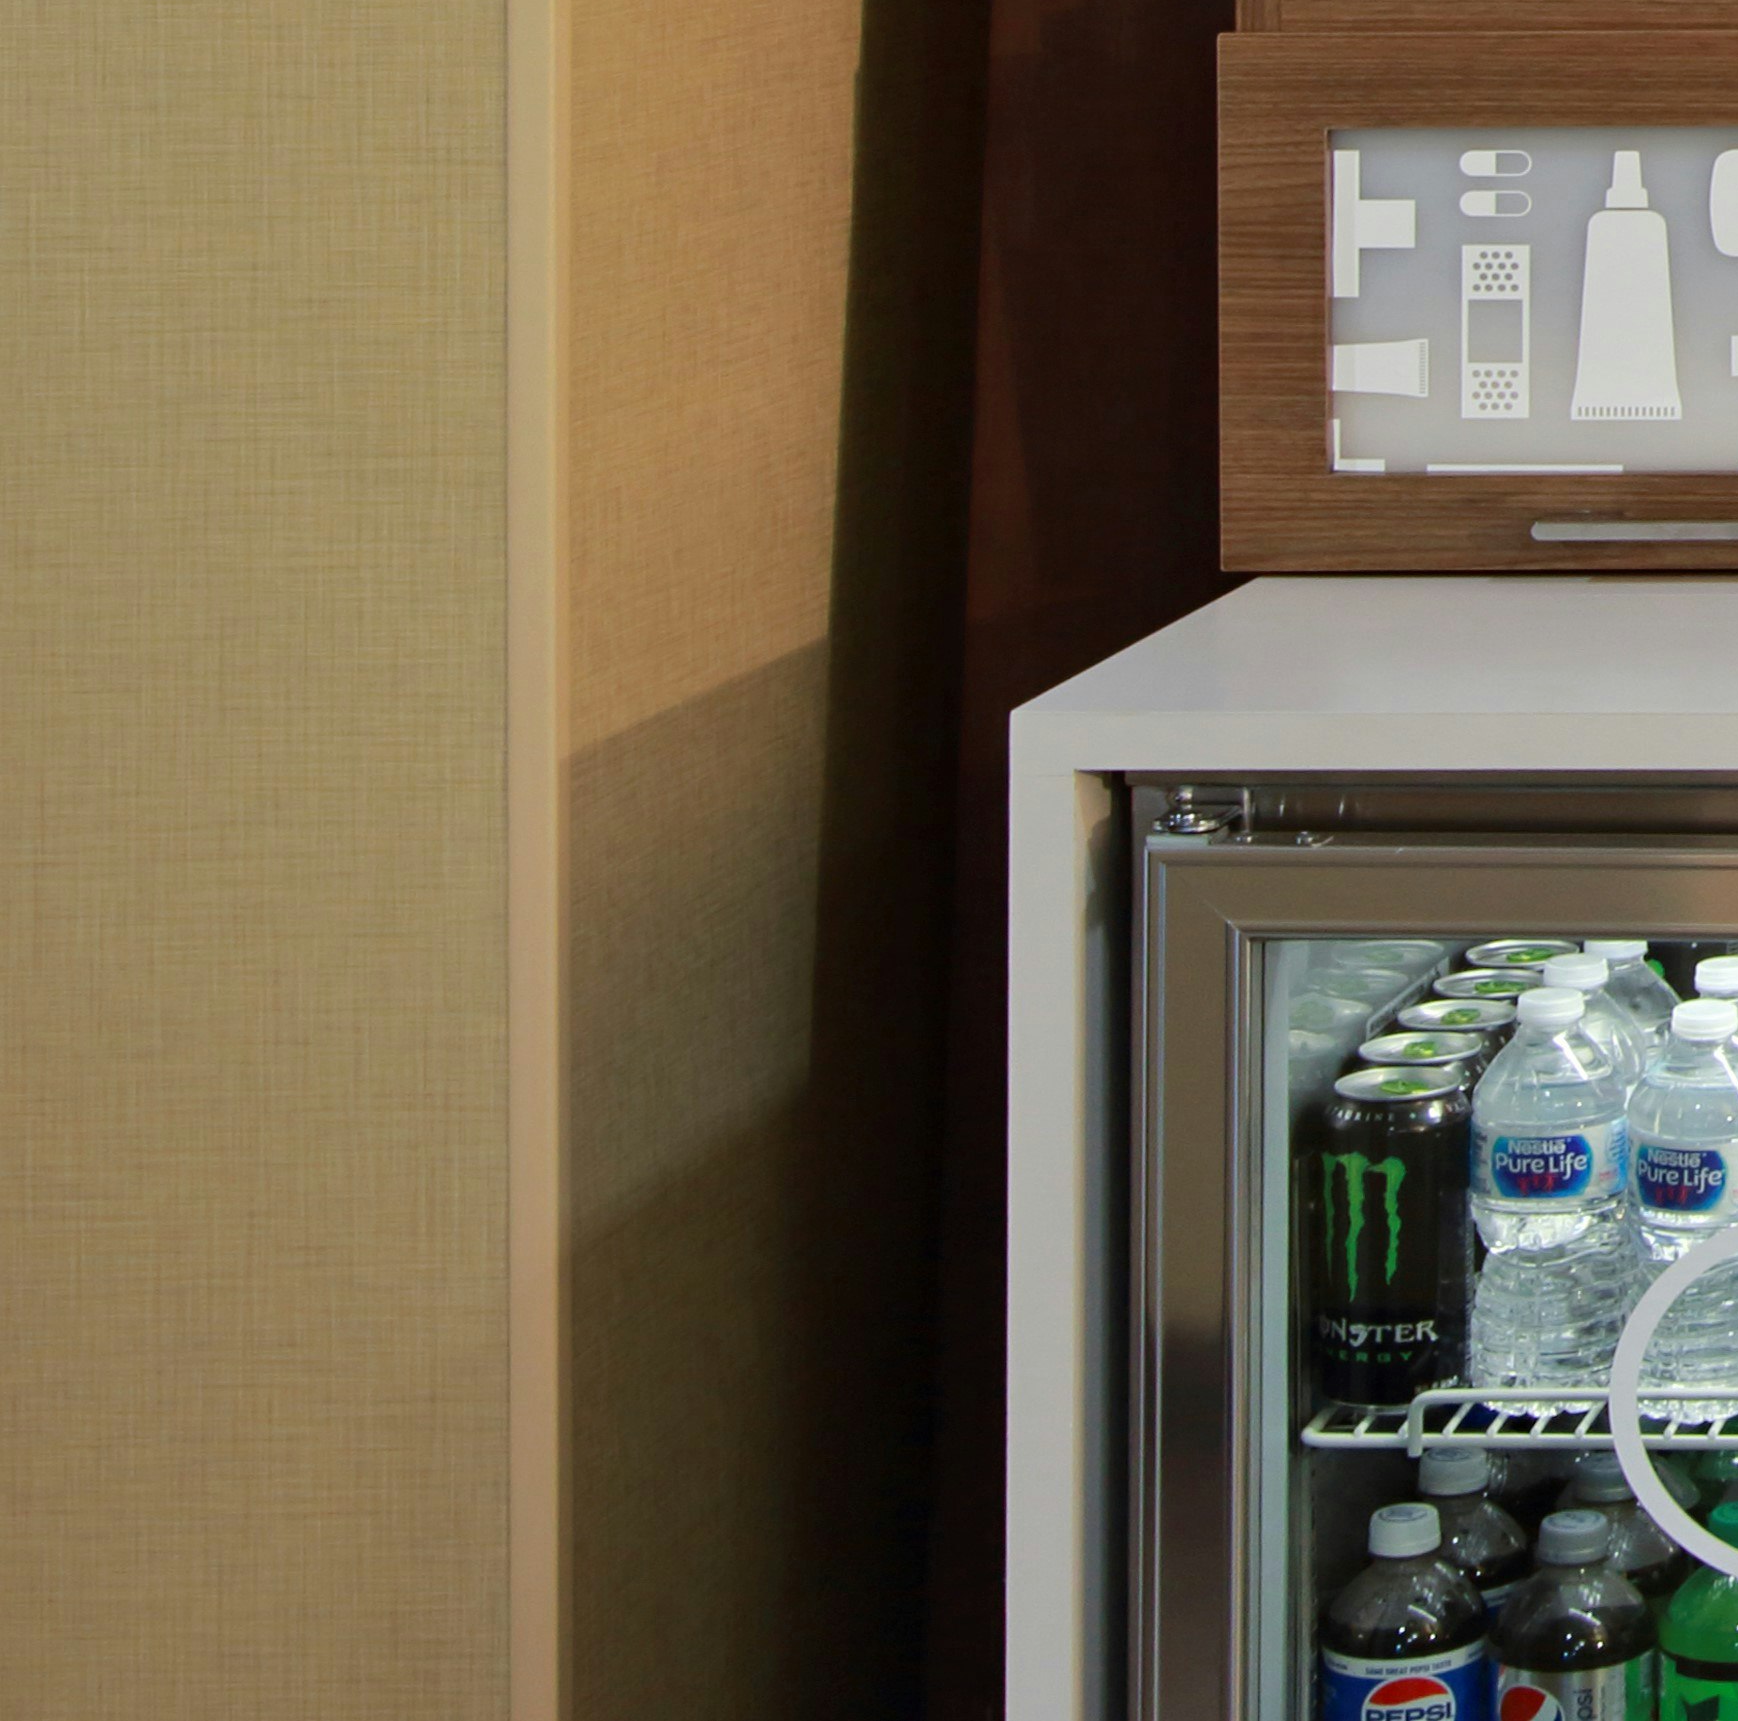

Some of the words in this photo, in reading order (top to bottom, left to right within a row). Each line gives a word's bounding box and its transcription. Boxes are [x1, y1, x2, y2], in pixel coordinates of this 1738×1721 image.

[1495, 1153, 1546, 1173] Pure
[1548, 1152, 1589, 1179] Life
[1638, 1160, 1680, 1185] Pure
[1683, 1167, 1724, 1194] Life
